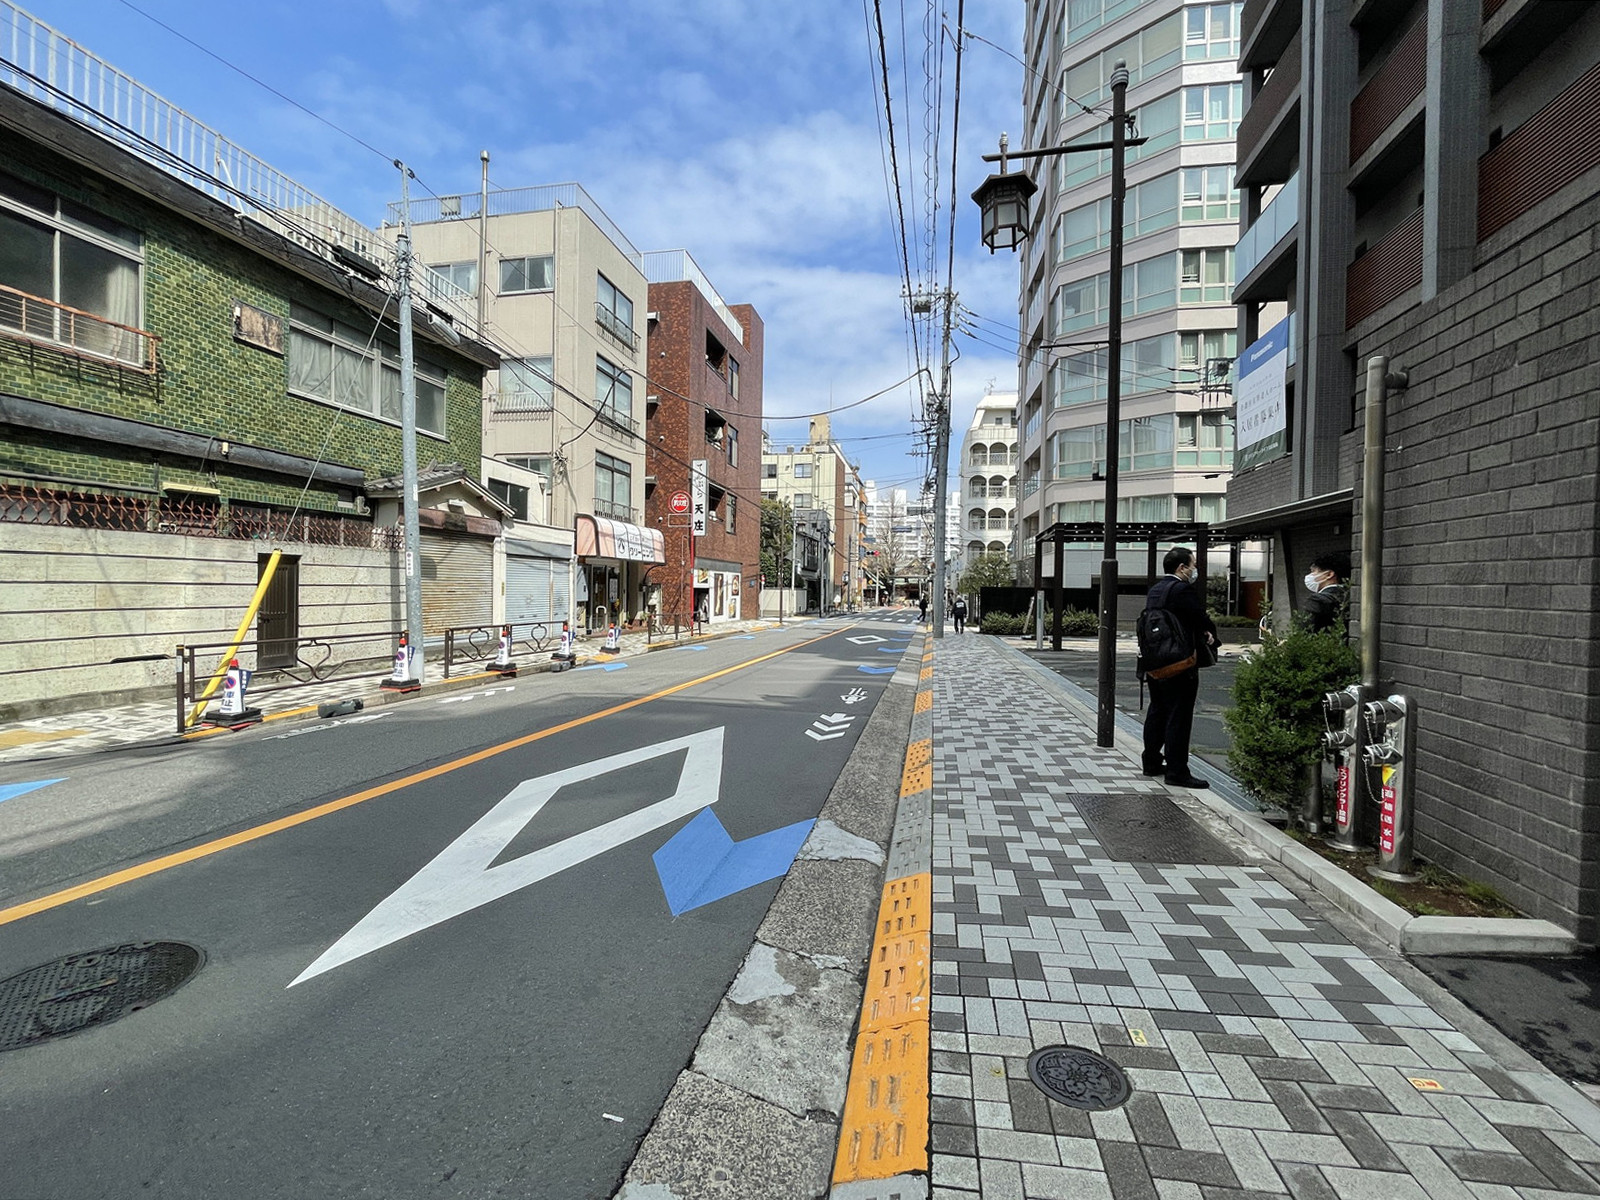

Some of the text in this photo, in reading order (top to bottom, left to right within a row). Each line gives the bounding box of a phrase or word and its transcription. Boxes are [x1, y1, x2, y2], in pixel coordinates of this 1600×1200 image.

[693, 503, 704, 531] 天庄
[629, 547, 654, 558] クリーニング
